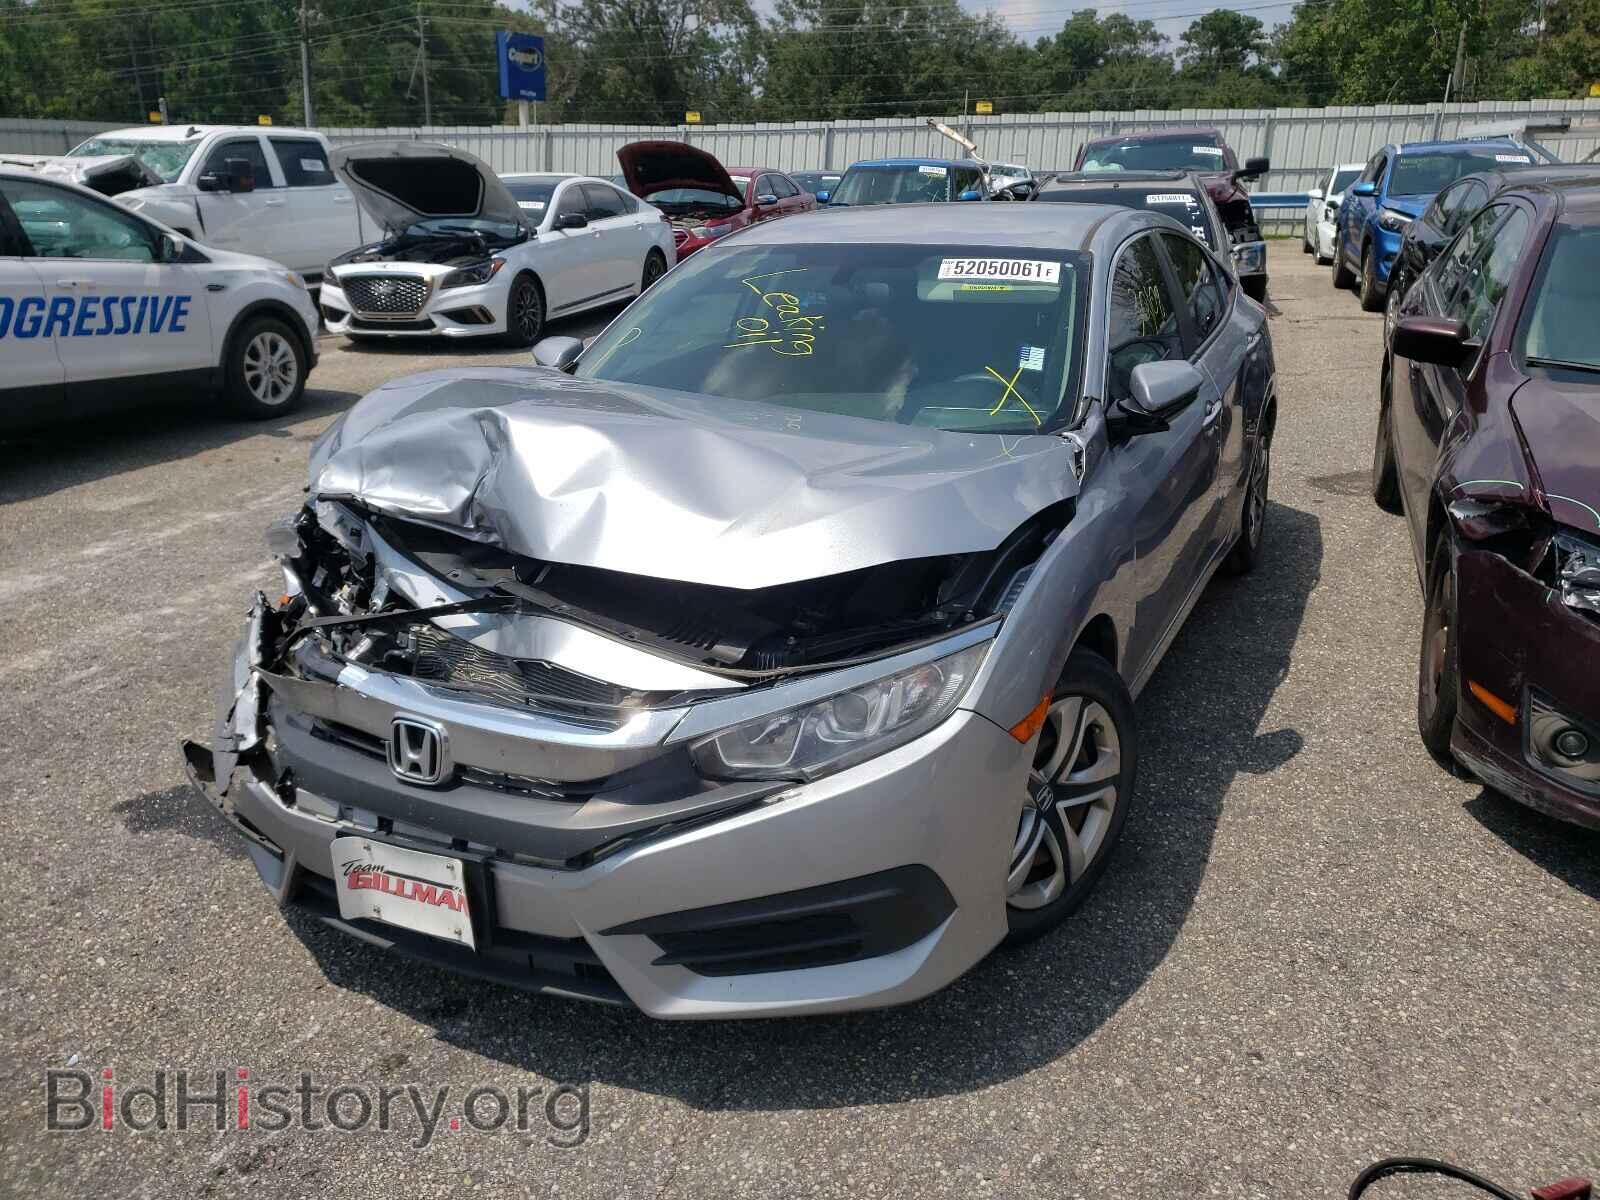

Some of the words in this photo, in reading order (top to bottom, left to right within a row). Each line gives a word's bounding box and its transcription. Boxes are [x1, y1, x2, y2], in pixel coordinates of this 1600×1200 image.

[953, 260, 1042, 277] 52050061
[741, 268, 825, 356] Leaking
[341, 858, 385, 877] Team
